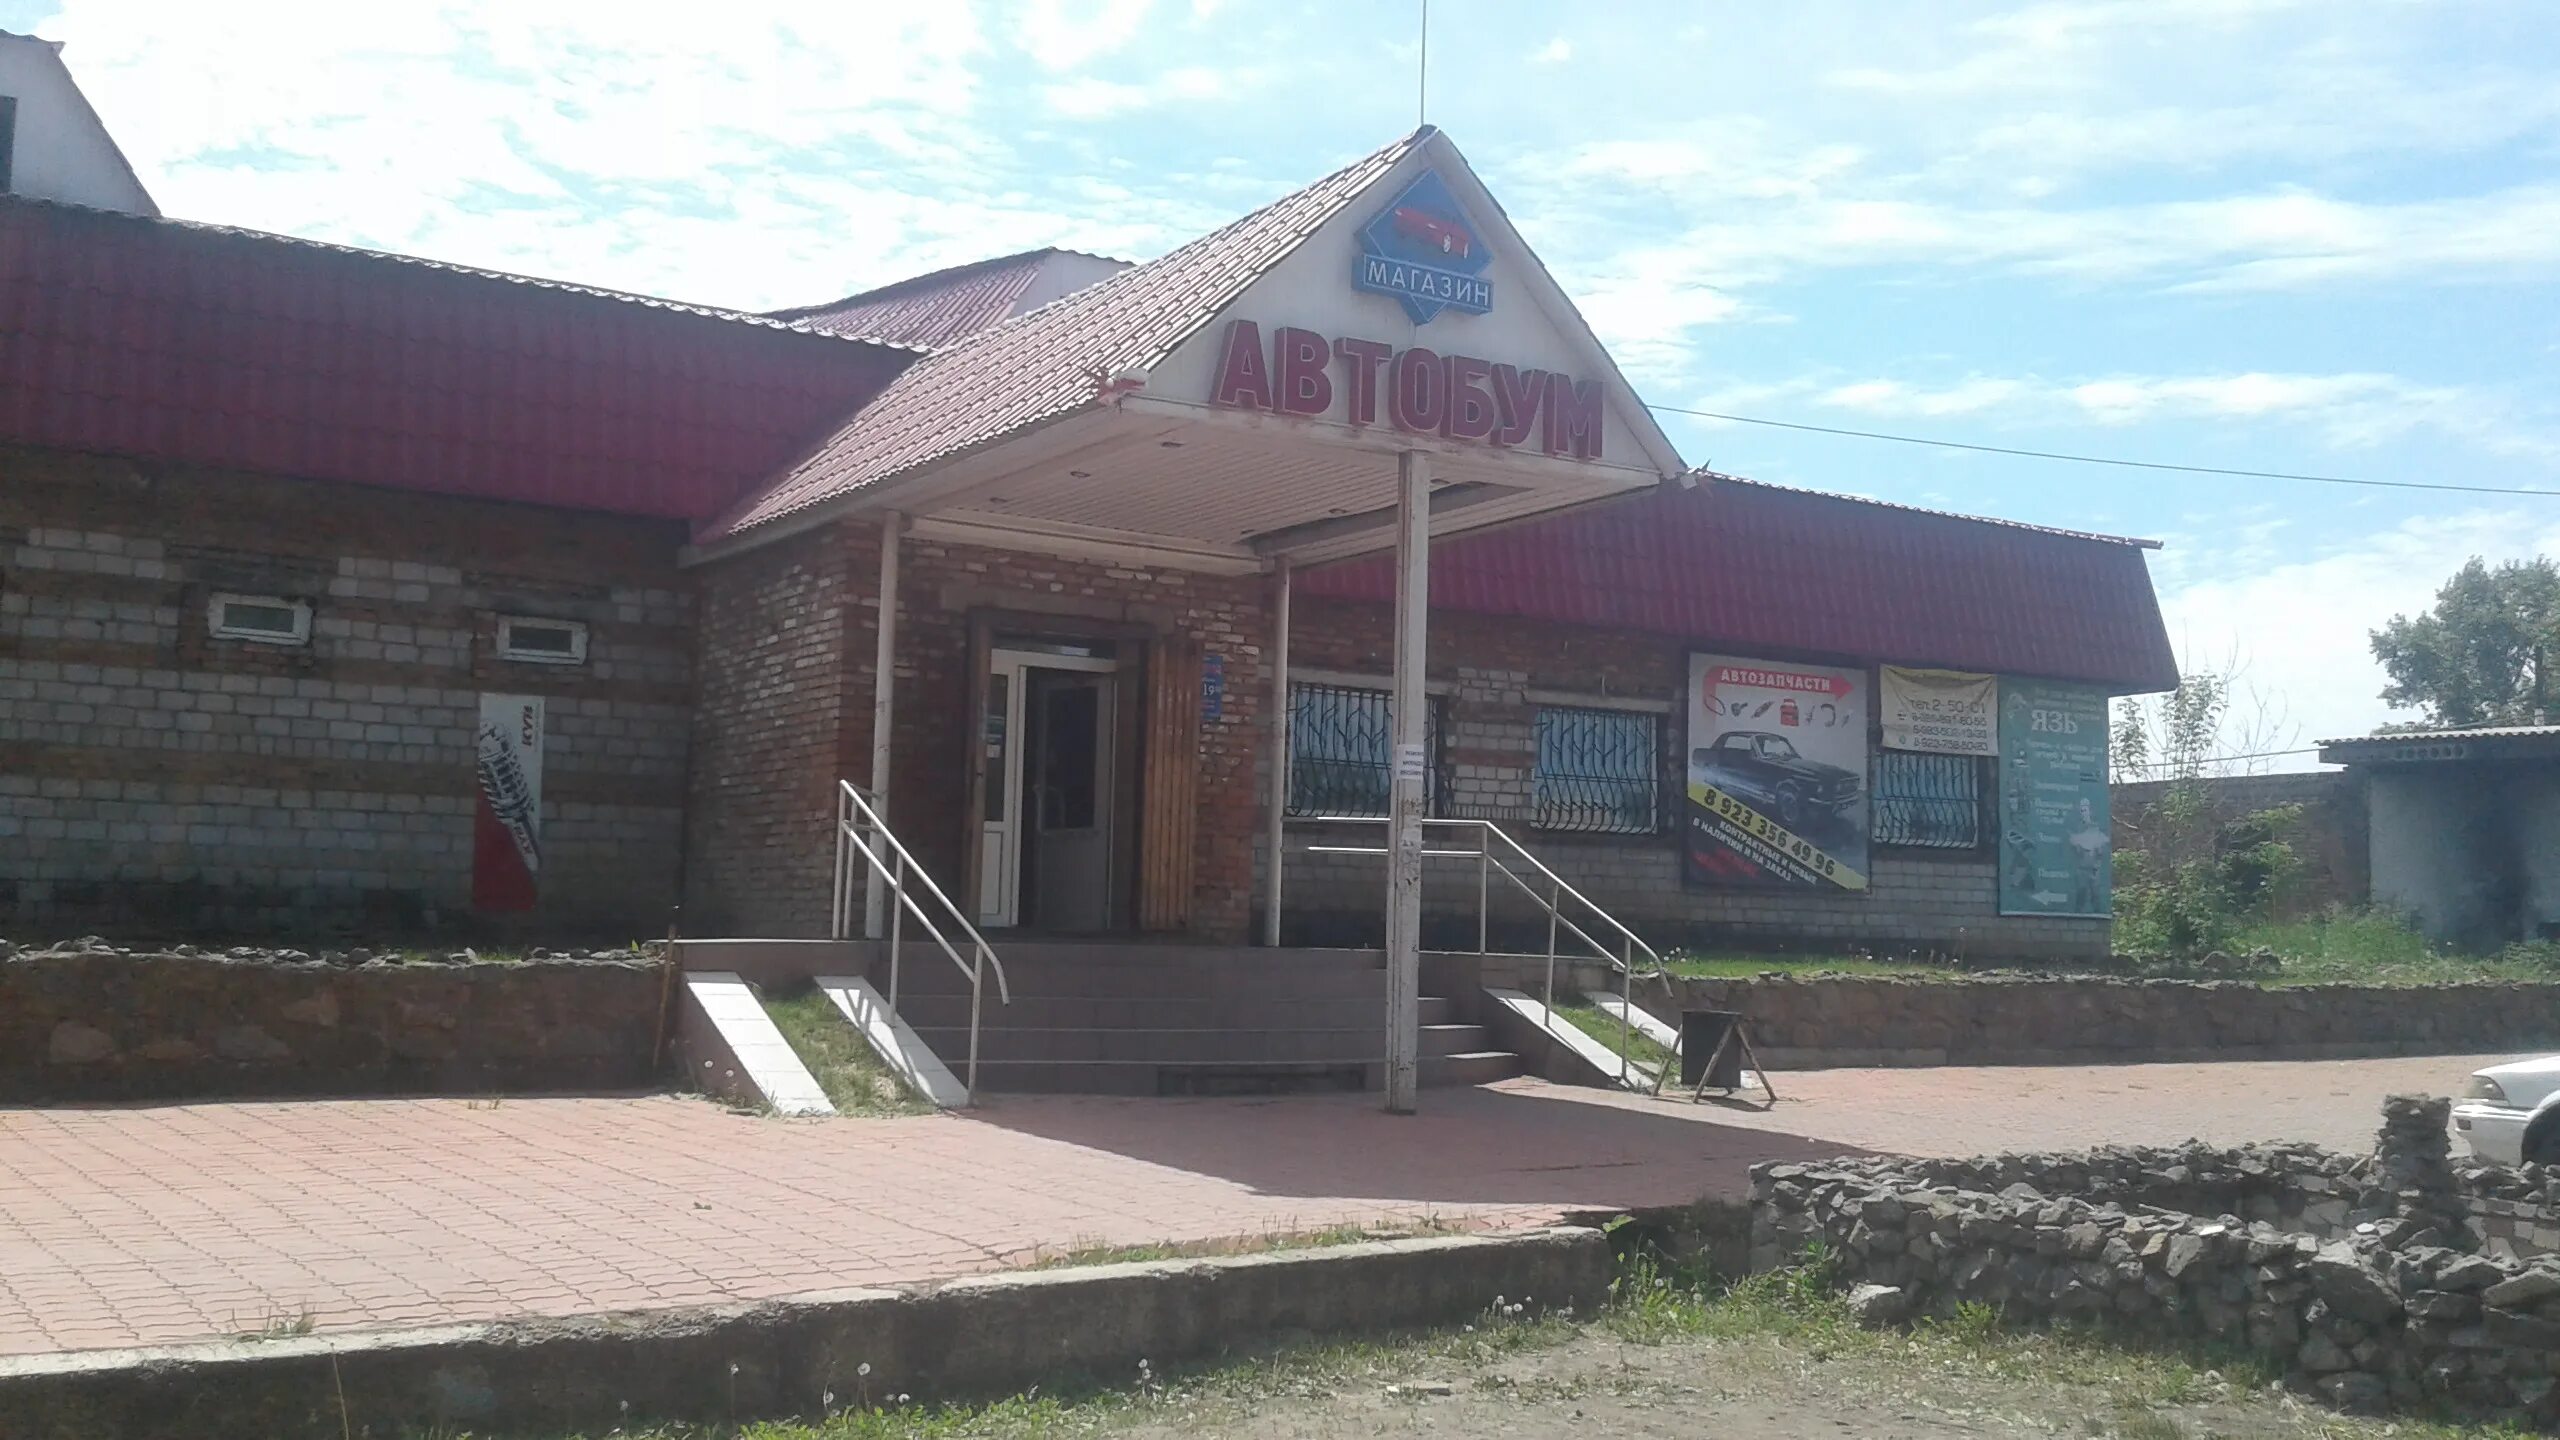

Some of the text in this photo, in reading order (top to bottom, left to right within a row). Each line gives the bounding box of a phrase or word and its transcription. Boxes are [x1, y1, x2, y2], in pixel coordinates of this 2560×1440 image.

[1368, 260, 1490, 307] МАГАЗИН
[1210, 320, 1603, 460] АВТОБУМ
[1720, 669, 1831, 691] АВТОЗАПЧАСТИ
[2031, 709, 2079, 735] ЯЗЬ
[1692, 817, 1700, 827] В
[1701, 821, 1744, 853] НАЛИЧИИ
[1751, 851, 1766, 867] НА
[1765, 859, 1793, 882] ЗАКАЗ
[1704, 788, 1836, 876] 8 923 356 49 96
[1719, 821, 1782, 864] КОНТРАКТНЫЕ
[1789, 861, 1818, 886] НОВЫЕ
